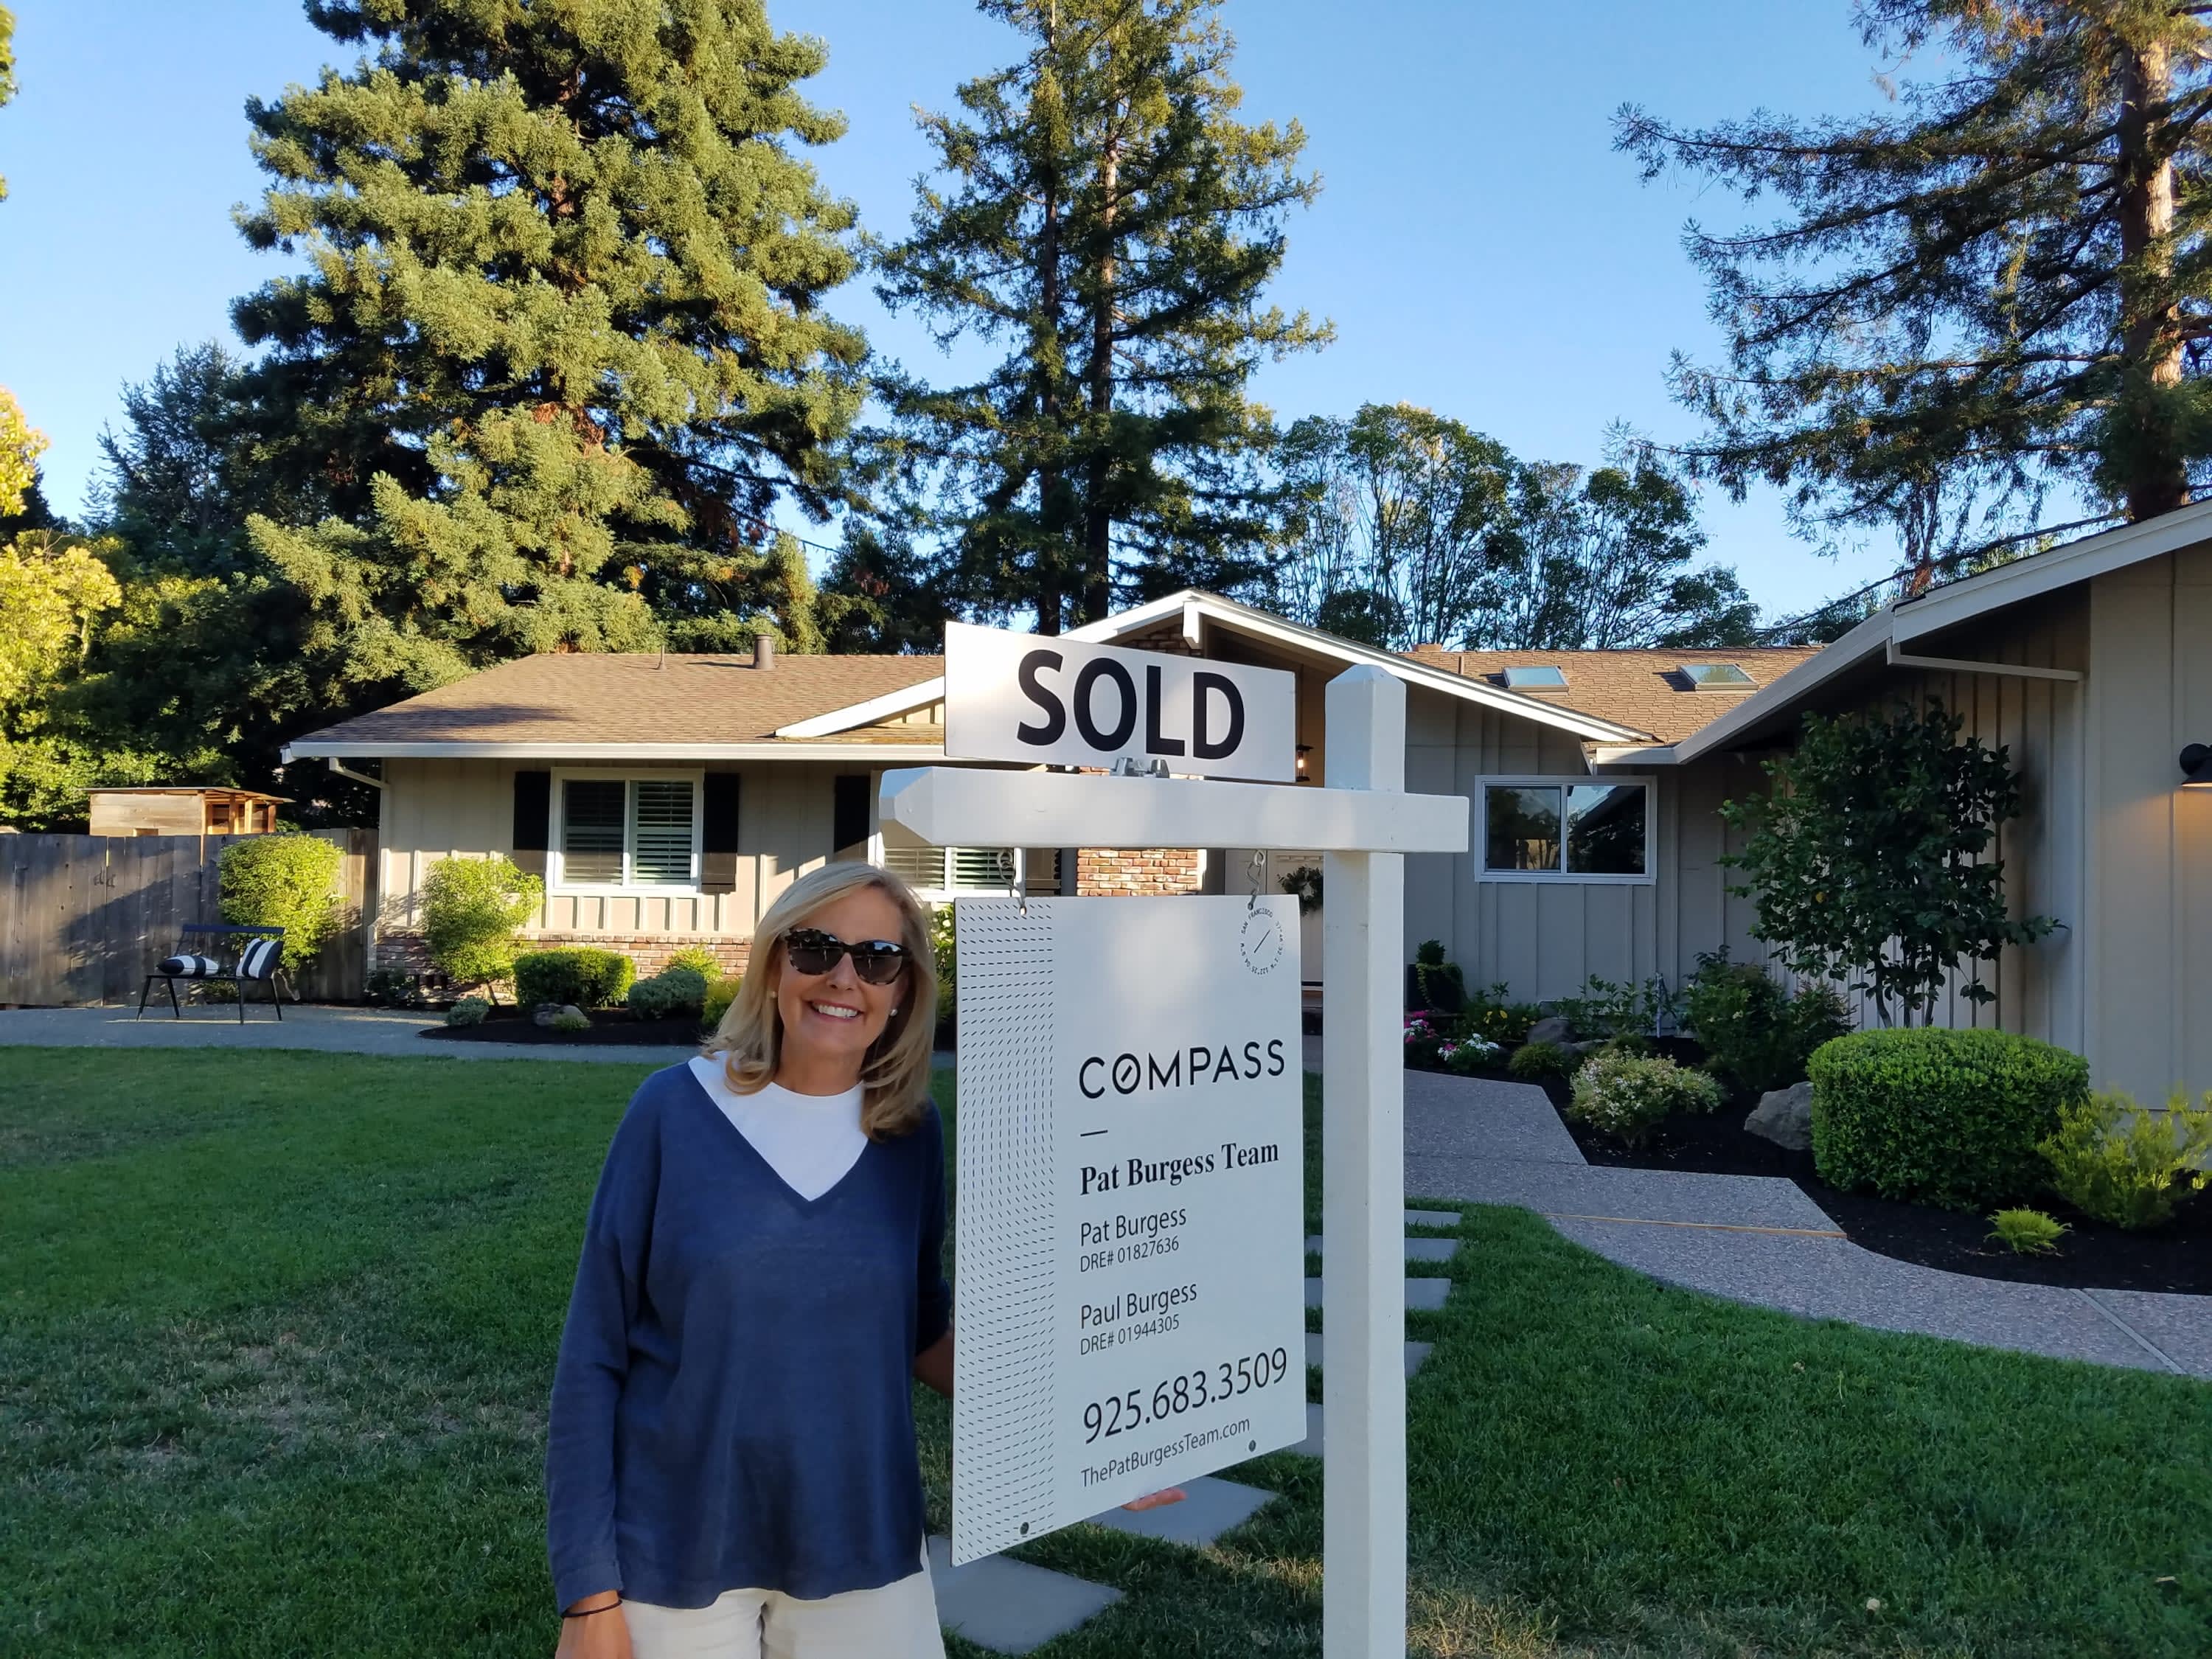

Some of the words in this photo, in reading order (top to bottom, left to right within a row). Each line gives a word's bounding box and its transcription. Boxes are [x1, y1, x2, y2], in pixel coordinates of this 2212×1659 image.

[1017, 650, 1245, 759] SOLD
[1079, 1039, 1285, 1099] COMPASS
[1080, 1164, 1120, 1196] Pat
[1127, 1154, 1215, 1187] Burgess
[1221, 1143, 1279, 1170] Team
[1080, 1220, 1110, 1248] Pat
[1116, 1208, 1186, 1239] Burgess
[1080, 1250, 1114, 1273] DRE#
[1117, 1236, 1180, 1264] 01827636
[1081, 1295, 1120, 1329] Paul
[1127, 1283, 1197, 1318] Burgess
[1080, 1331, 1115, 1356] DRE#
[1118, 1314, 1180, 1345] 01944305
[1083, 1346, 1287, 1445] 925.683.3509
[1080, 1418, 1250, 1487] ThePatBurgessTeam.com
